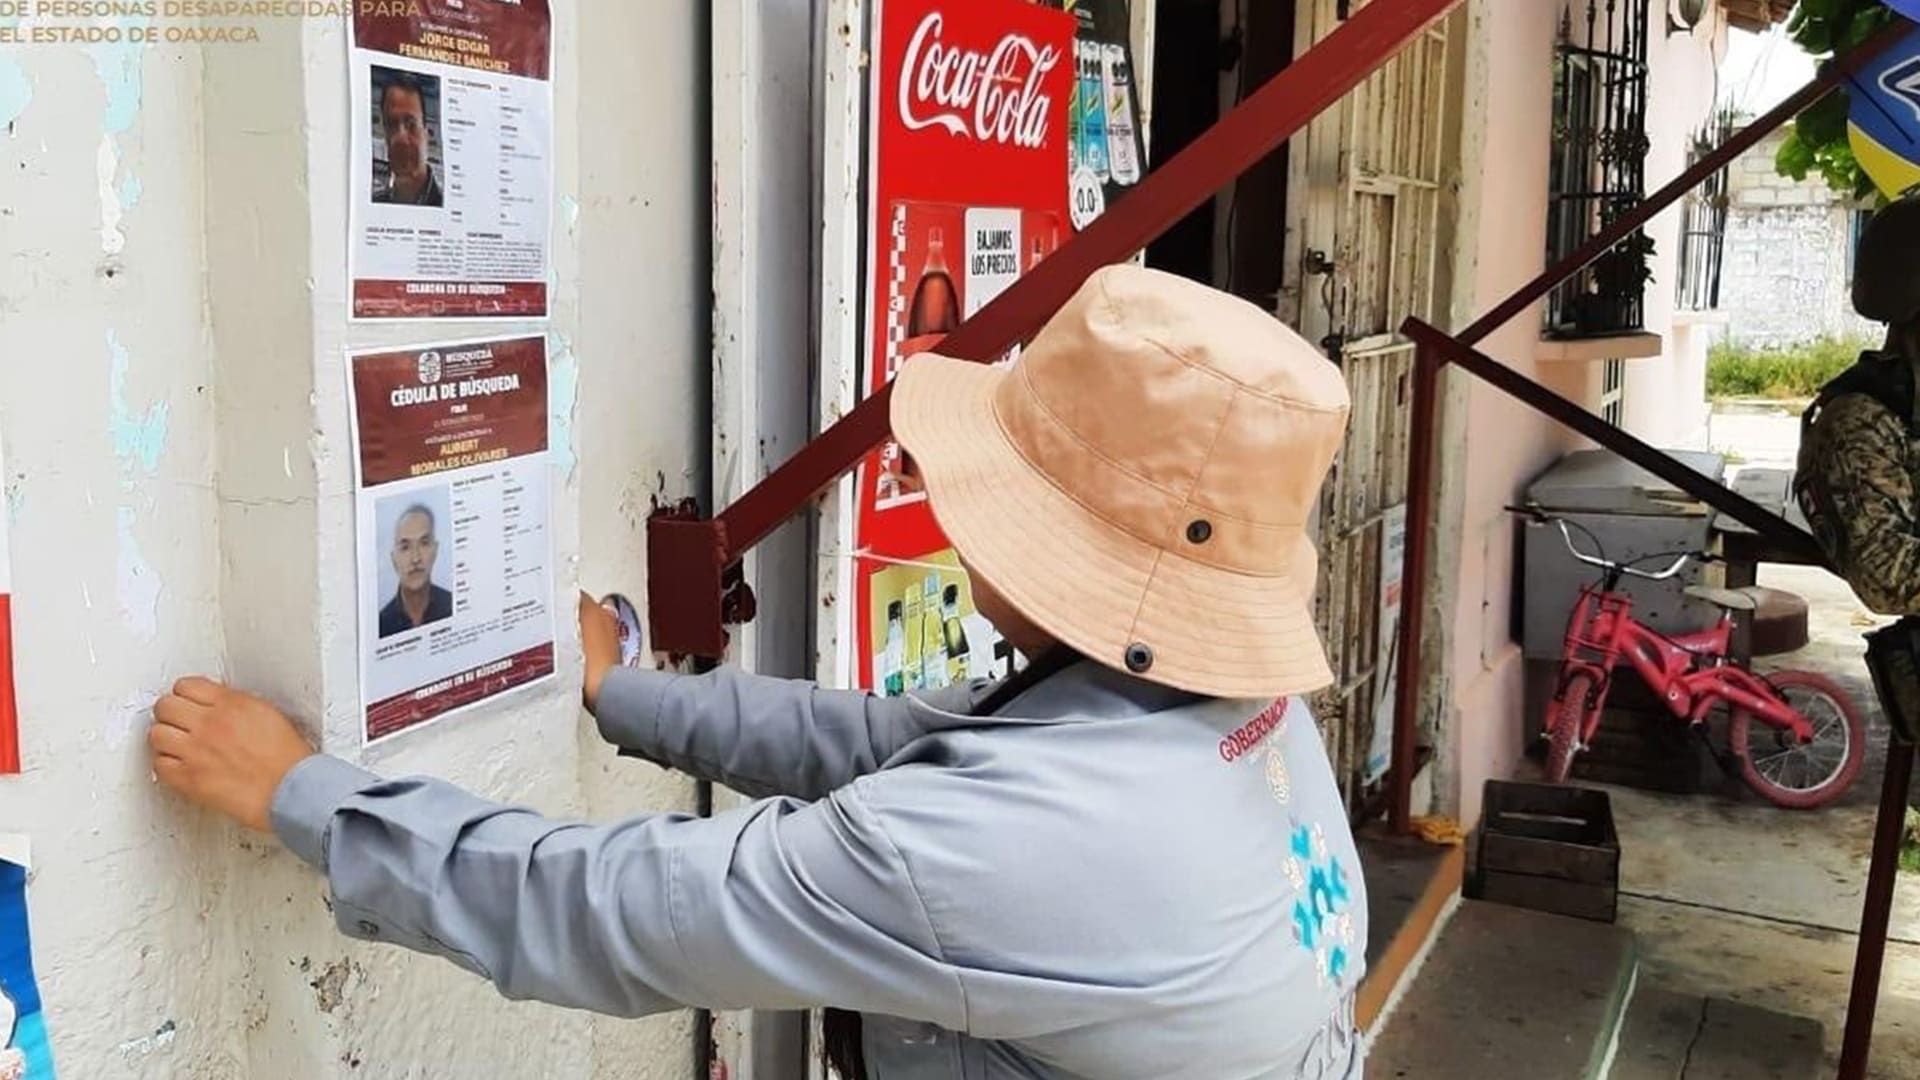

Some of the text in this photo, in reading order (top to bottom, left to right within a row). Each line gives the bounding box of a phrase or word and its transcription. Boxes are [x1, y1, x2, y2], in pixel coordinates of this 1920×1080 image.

[420, 31, 456, 49] JORGE
[456, 38, 491, 56] EDGAR
[898, 11, 1062, 149] Coca-Cola
[976, 229, 1013, 251] BAJAMOS
[971, 254, 1017, 276] LOS PRECIOS
[391, 374, 521, 407] CÉDULA DE BÚSQUEDA
[410, 459, 460, 477] MORALES
